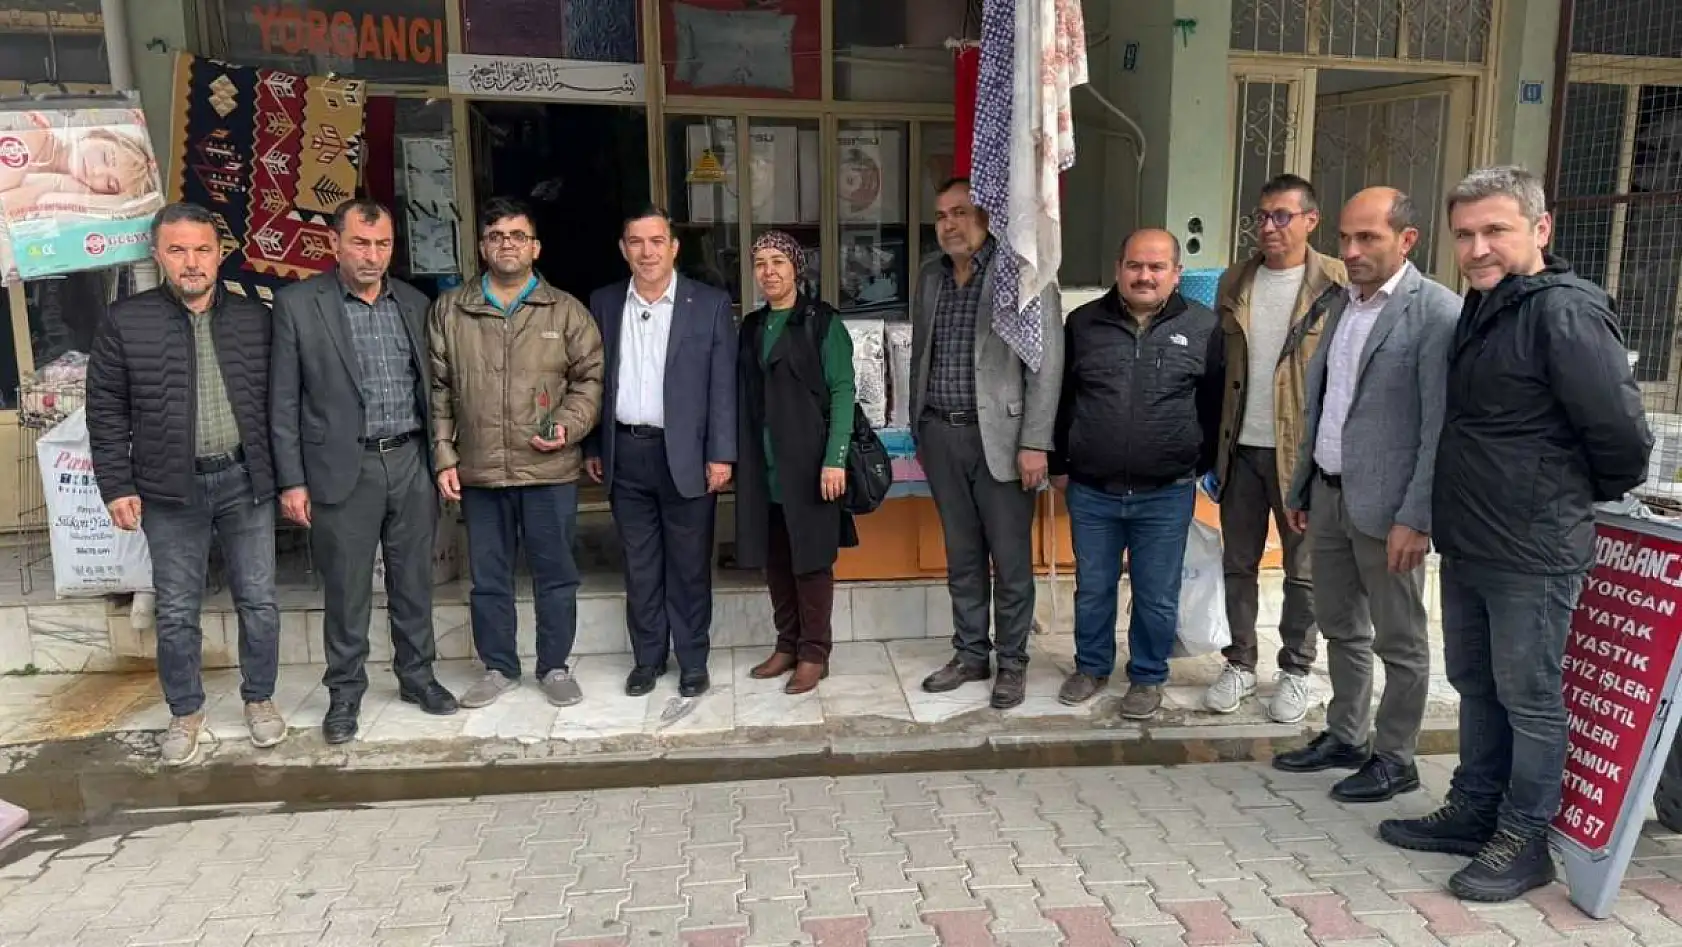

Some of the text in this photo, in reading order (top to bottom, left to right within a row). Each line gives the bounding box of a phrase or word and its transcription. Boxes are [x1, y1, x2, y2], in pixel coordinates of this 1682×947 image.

[252, 4, 442, 64] YORGANCI
[1595, 534, 1682, 588] ORGANC
[1587, 576, 1676, 616] YORGAN
[1588, 606, 1654, 641] YATAK
[1575, 631, 1650, 672] YASTIK
[1572, 685, 1636, 729] TEKSTİL
[1599, 668, 1655, 705] İŞLERİ
[1567, 741, 1622, 783] PAMUK
[1563, 804, 1584, 828] 46
[1583, 813, 1606, 839] 57
